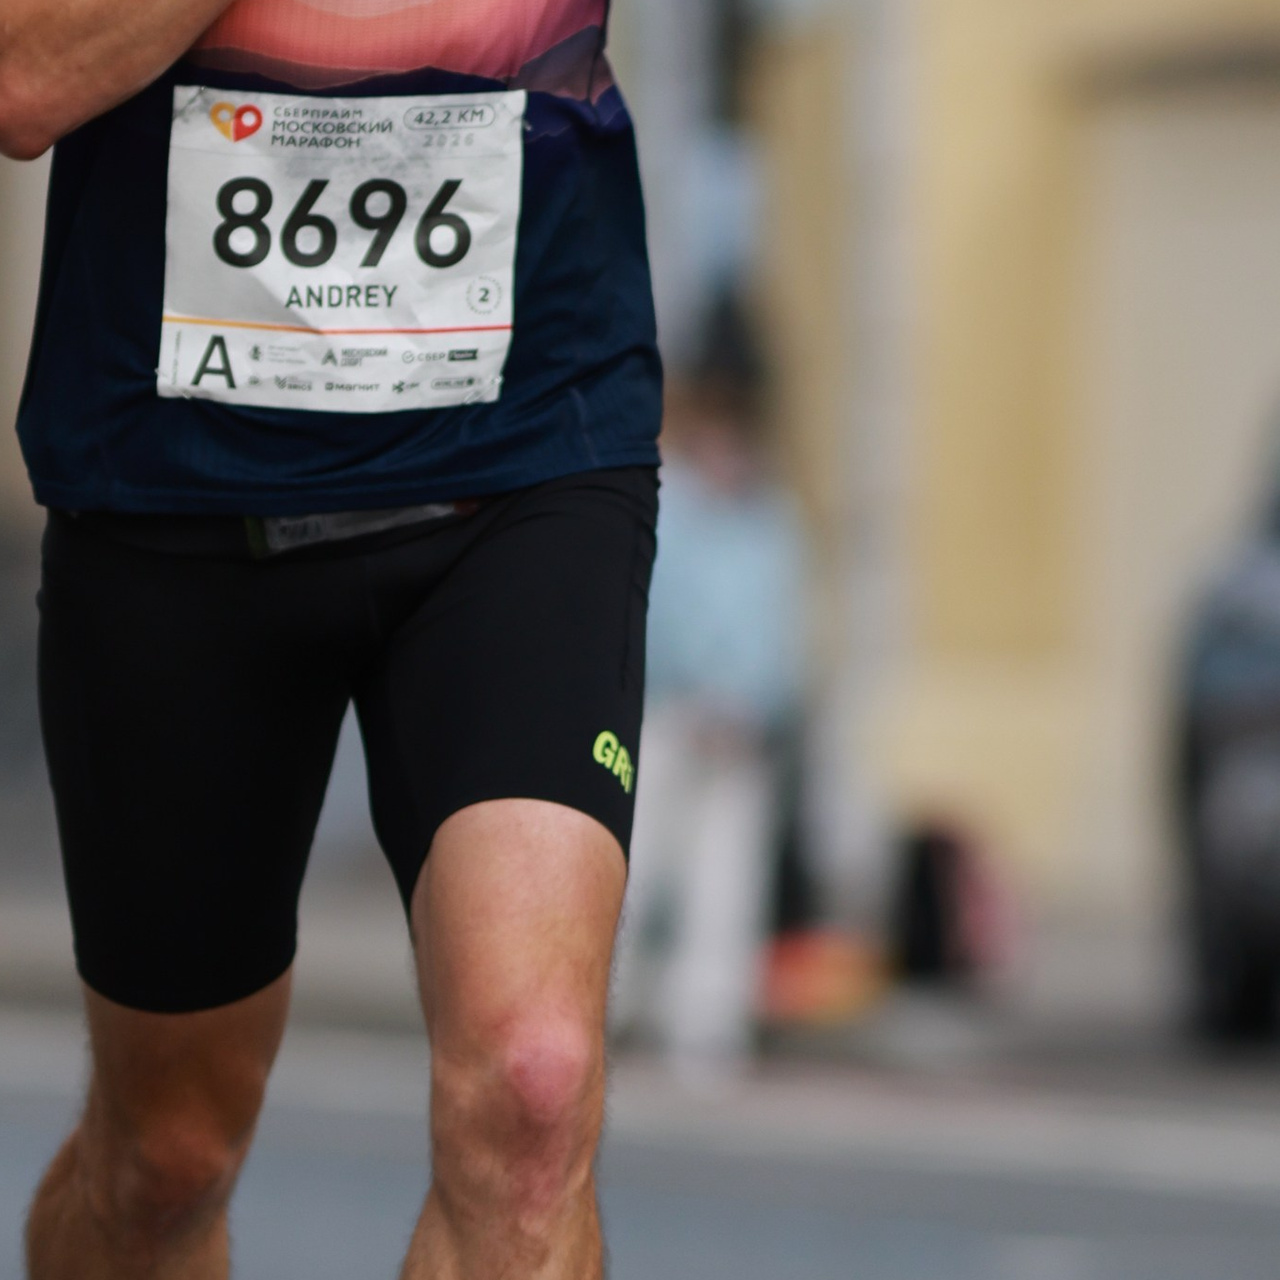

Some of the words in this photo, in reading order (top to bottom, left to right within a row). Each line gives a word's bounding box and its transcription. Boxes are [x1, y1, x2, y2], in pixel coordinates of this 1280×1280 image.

[273, 106, 363, 119] СБЕРПРАЙМ
[413, 110, 451, 126] 42,2
[271, 119, 393, 134] МОСКОВСКИЙ
[271, 134, 361, 149] МАРАФОН
[212, 176, 472, 269] 8696
[285, 284, 398, 309] ANDREY
[478, 287, 490, 303] 2
[417, 352, 446, 362] СБЕР
